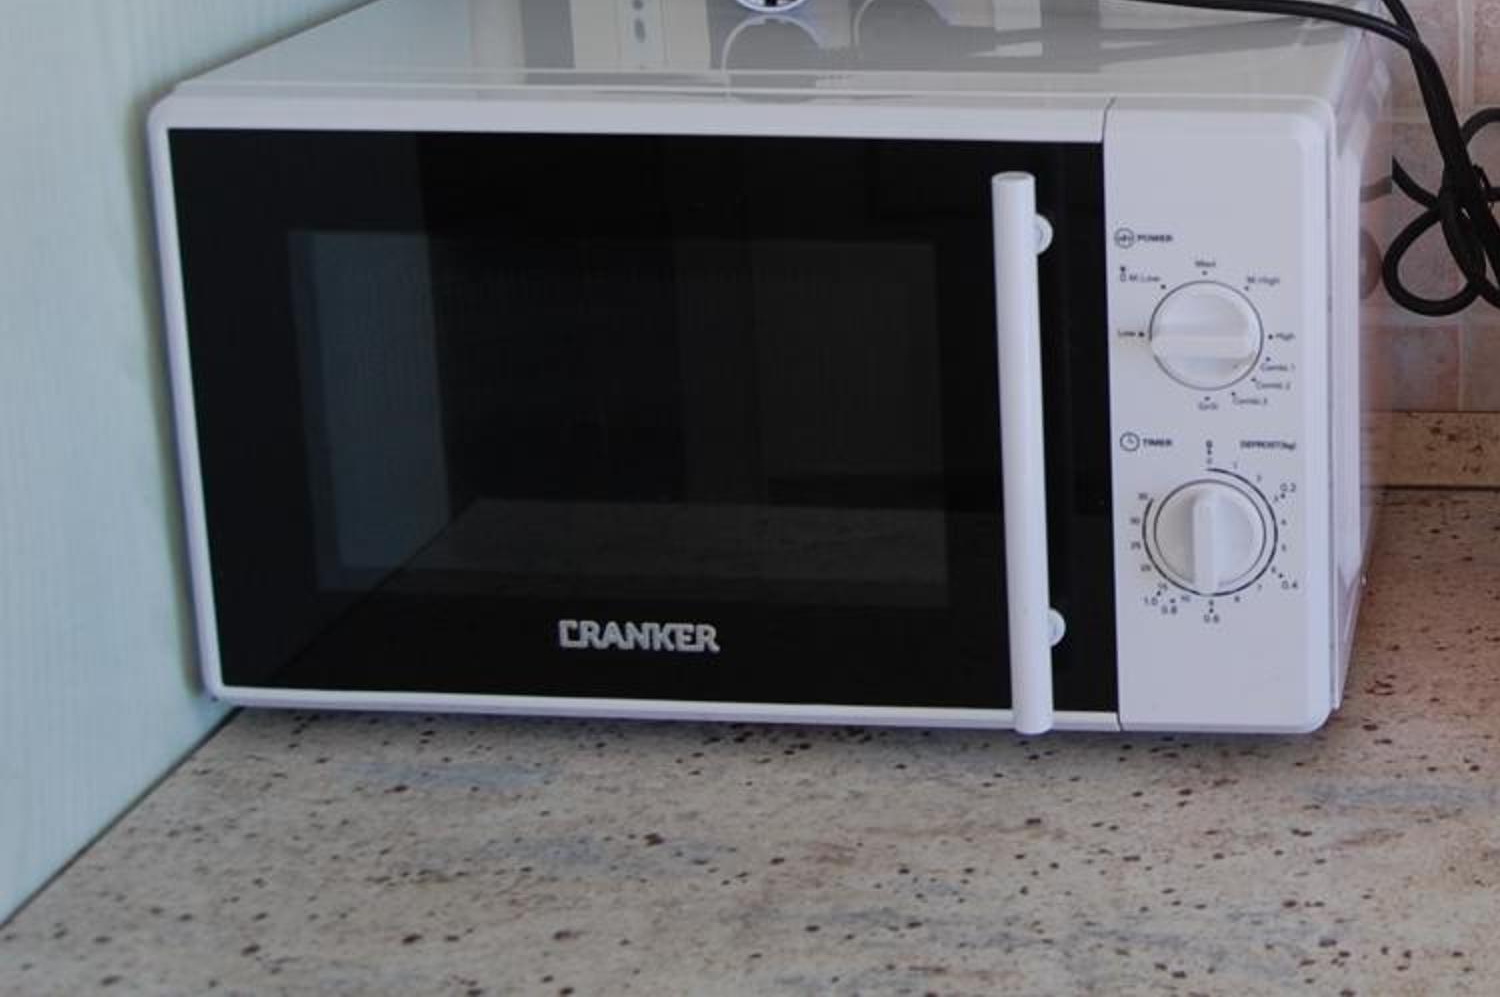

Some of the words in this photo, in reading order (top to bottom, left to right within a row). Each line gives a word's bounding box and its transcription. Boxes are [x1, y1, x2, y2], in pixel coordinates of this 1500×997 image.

[1137, 233, 1174, 243] POWER
[1142, 438, 1173, 447] TIMER
[558, 619, 720, 653] CRANKER
